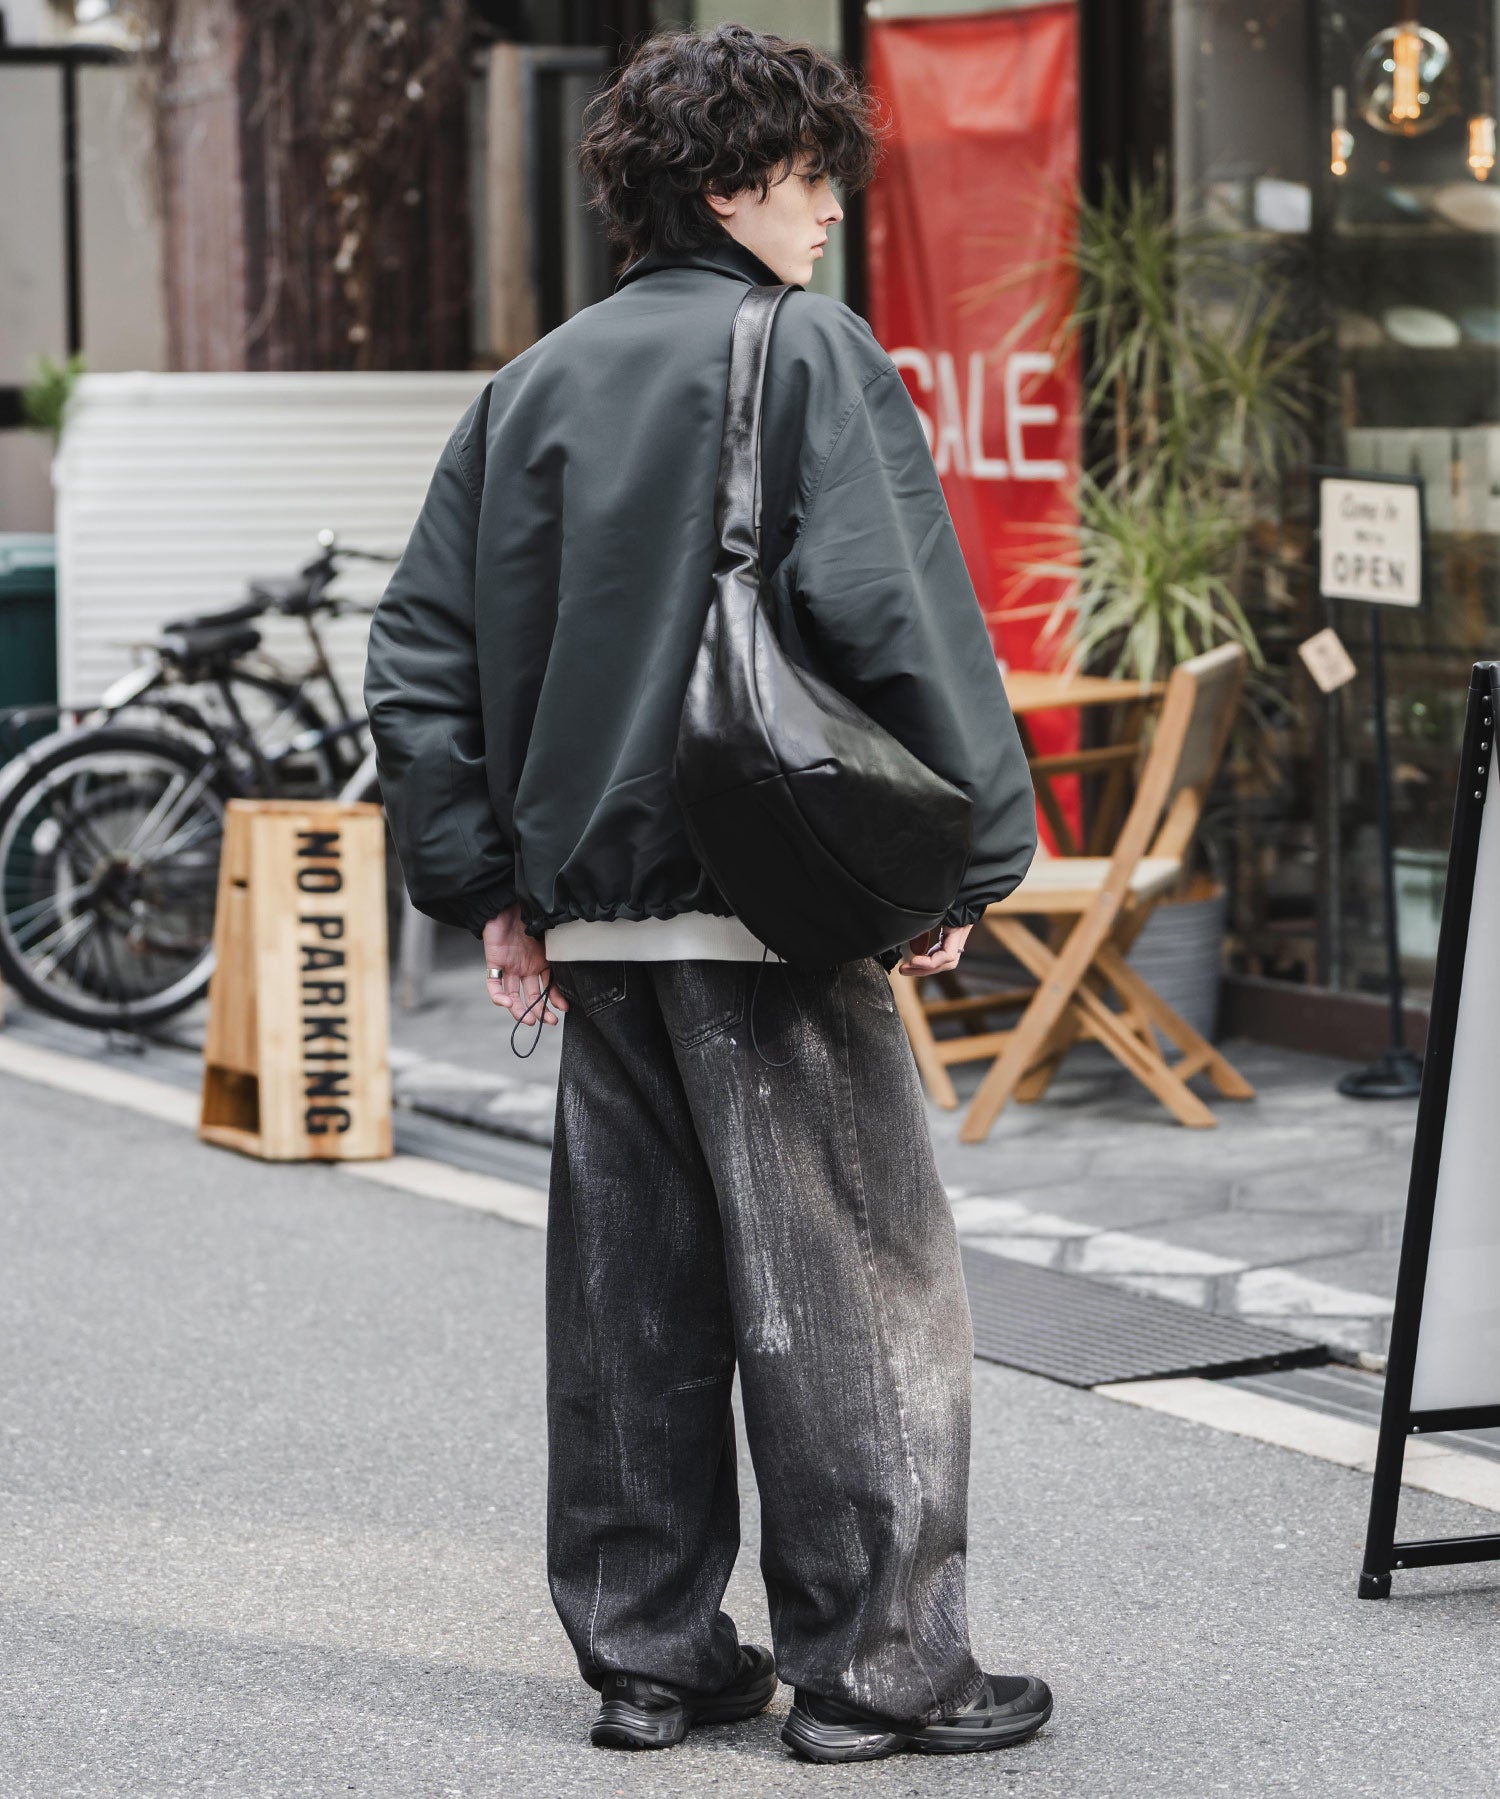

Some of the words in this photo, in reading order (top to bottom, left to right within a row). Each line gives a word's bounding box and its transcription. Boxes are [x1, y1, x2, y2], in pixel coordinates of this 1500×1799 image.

[1332, 551, 1404, 589] OPEN
[296, 830, 344, 894] NO
[299, 914, 352, 1136] PARKING
